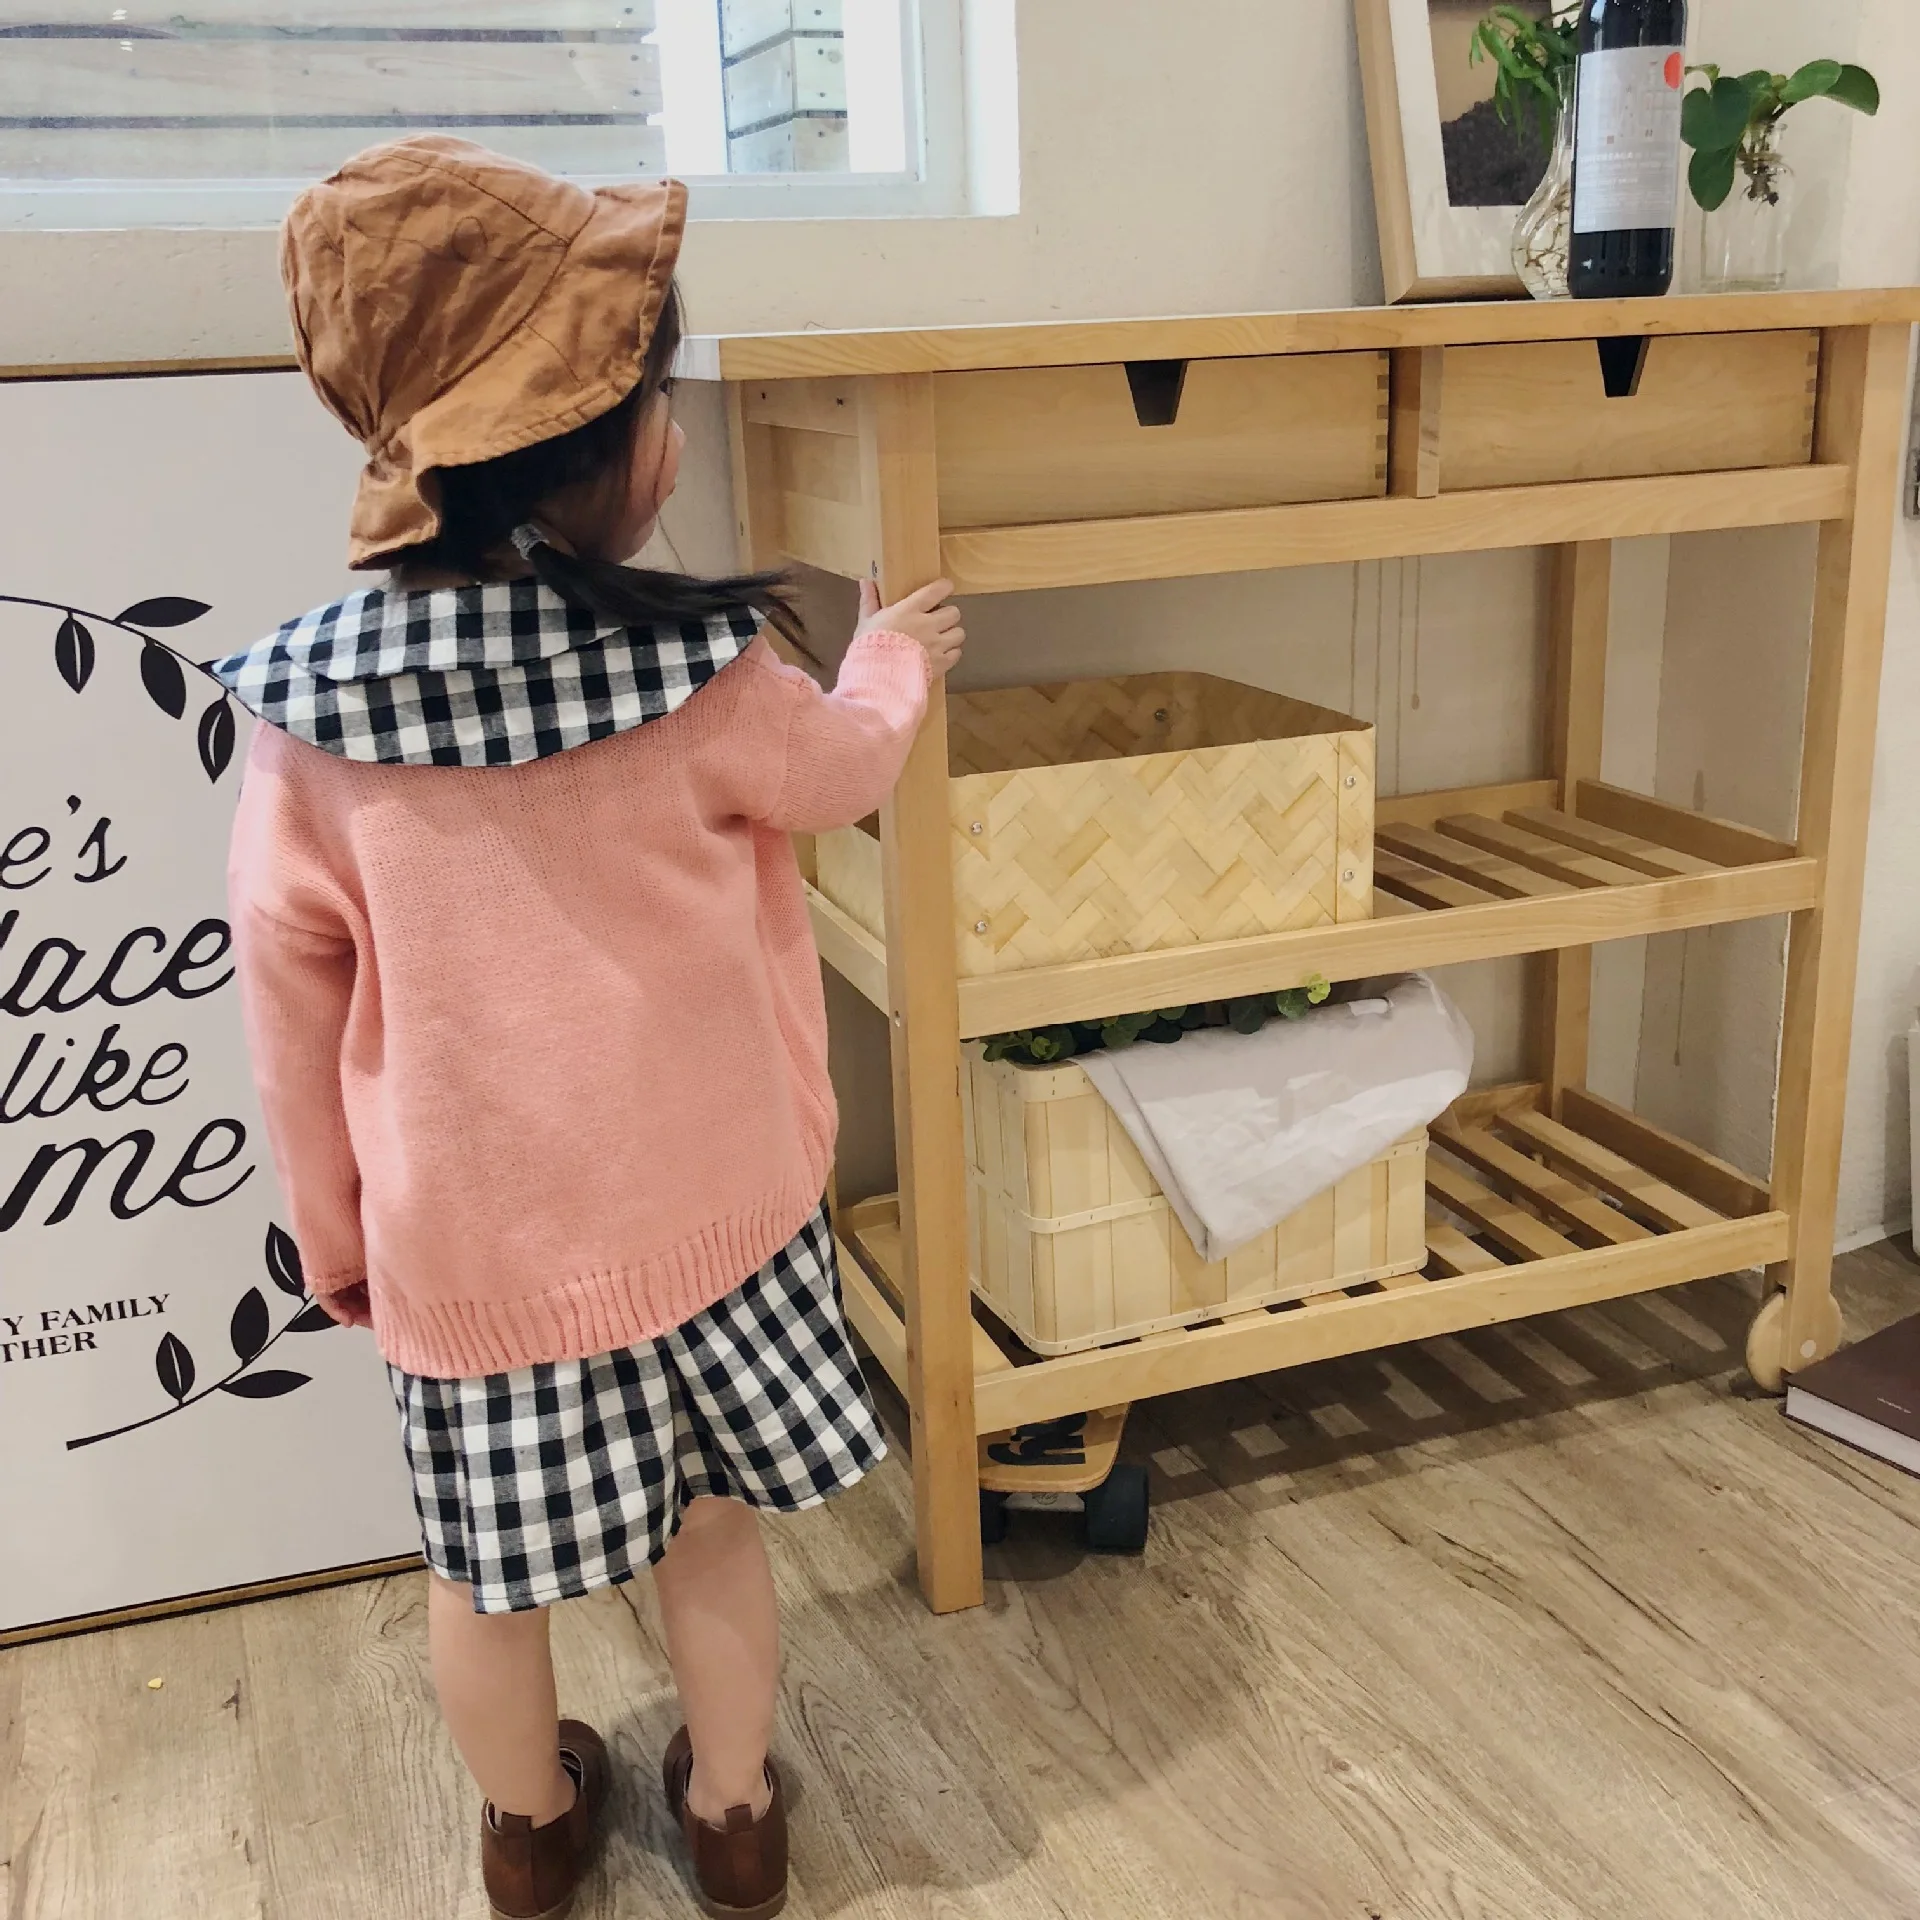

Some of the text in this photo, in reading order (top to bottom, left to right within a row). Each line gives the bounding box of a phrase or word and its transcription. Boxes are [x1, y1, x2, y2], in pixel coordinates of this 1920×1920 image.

[0, 1023, 190, 1124] like
[0, 1118, 256, 1232] me
[0, 1331, 99, 1363] THER
[40, 1293, 170, 1332] FAMILY
